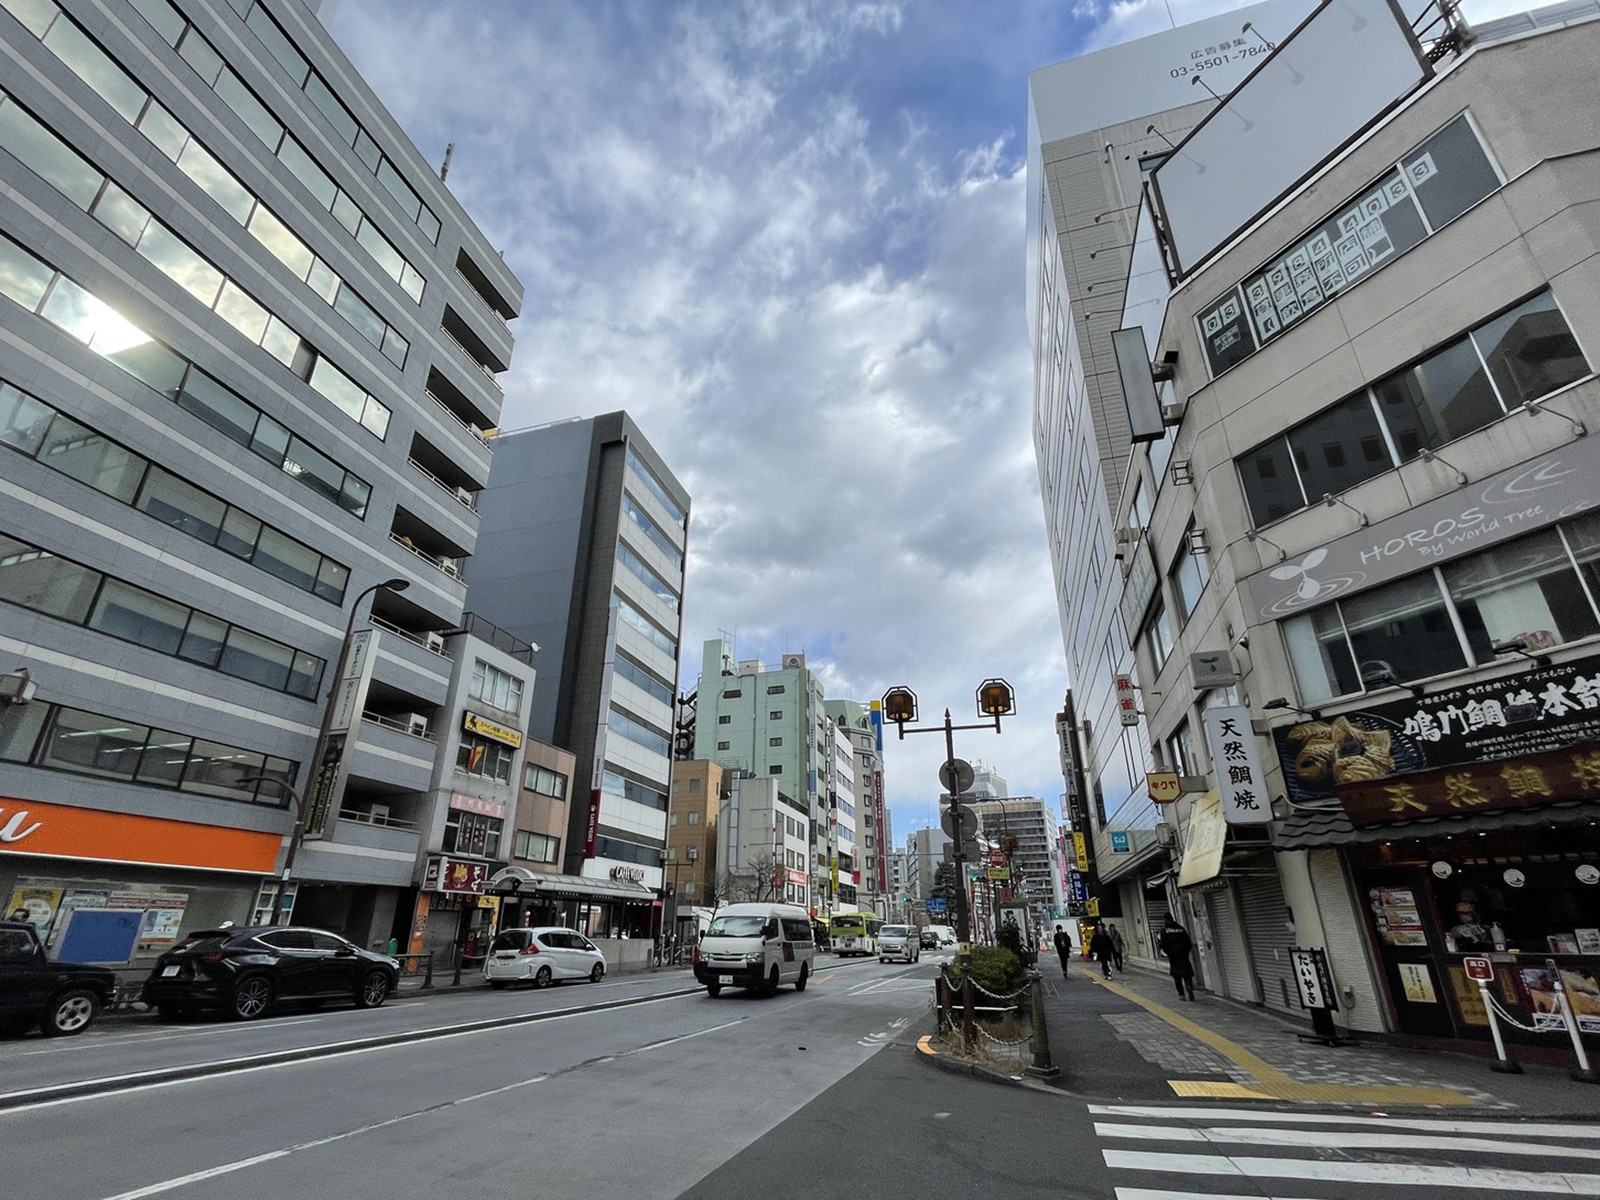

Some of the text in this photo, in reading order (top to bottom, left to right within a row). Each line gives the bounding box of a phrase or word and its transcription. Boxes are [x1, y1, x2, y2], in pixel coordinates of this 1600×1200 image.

[1170, 42, 1276, 78] 03-5501-7840
[1190, 38, 1247, 60] 広告募集
[1360, 507, 1485, 565] HOROS
[1418, 505, 1545, 557] By World Tree
[1523, 665, 1576, 683] アイスもなか
[1117, 678, 1135, 711] 麻雀
[1122, 714, 1138, 723] エイト
[1219, 717, 1260, 811] 天然鯛焼
[1151, 780, 1177, 791] キクヤ
